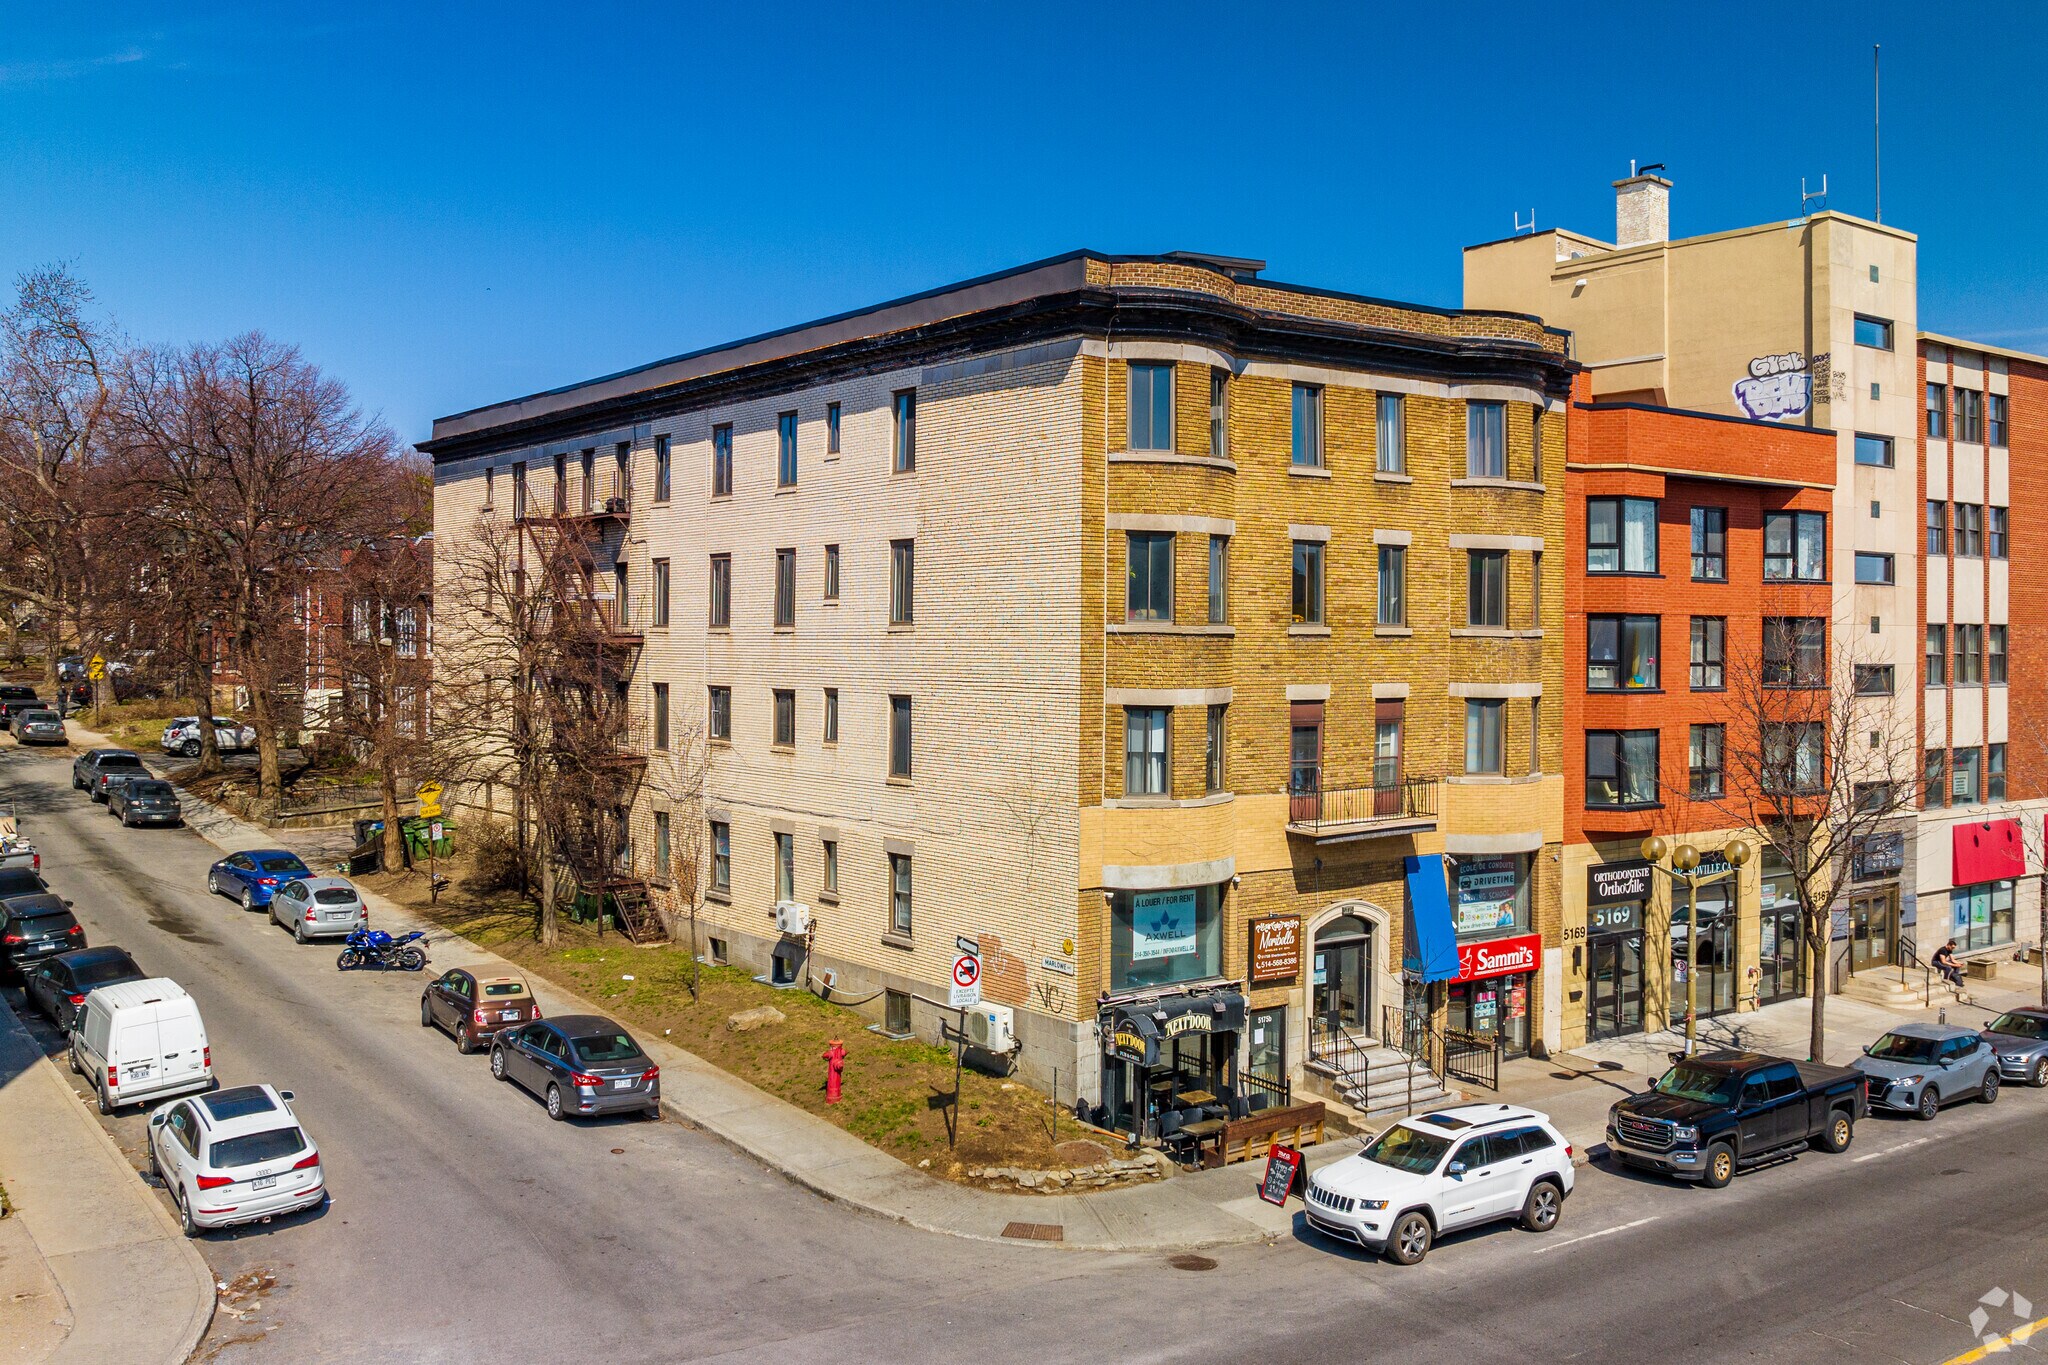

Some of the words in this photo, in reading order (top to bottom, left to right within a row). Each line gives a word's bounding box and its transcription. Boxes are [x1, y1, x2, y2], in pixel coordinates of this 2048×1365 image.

[1474, 874, 1514, 886] DRIVETIME
[1594, 867, 1650, 883] ORTHODONTISTE
[1141, 897, 1162, 908] LOUER
[1166, 896, 1179, 905] FOR
[1179, 894, 1194, 903] RENT
[1488, 890, 1511, 899] SCHOOL
[1596, 905, 1631, 926] 5169
[1145, 929, 1187, 942] AXWELL
[1563, 926, 1586, 940] 5169
[1044, 957, 1067, 970] MARLOWE
[1165, 1014, 1188, 1038] NEXT
[1188, 1014, 1212, 1031] DOOR
[1115, 1033, 1131, 1046] NEXT
